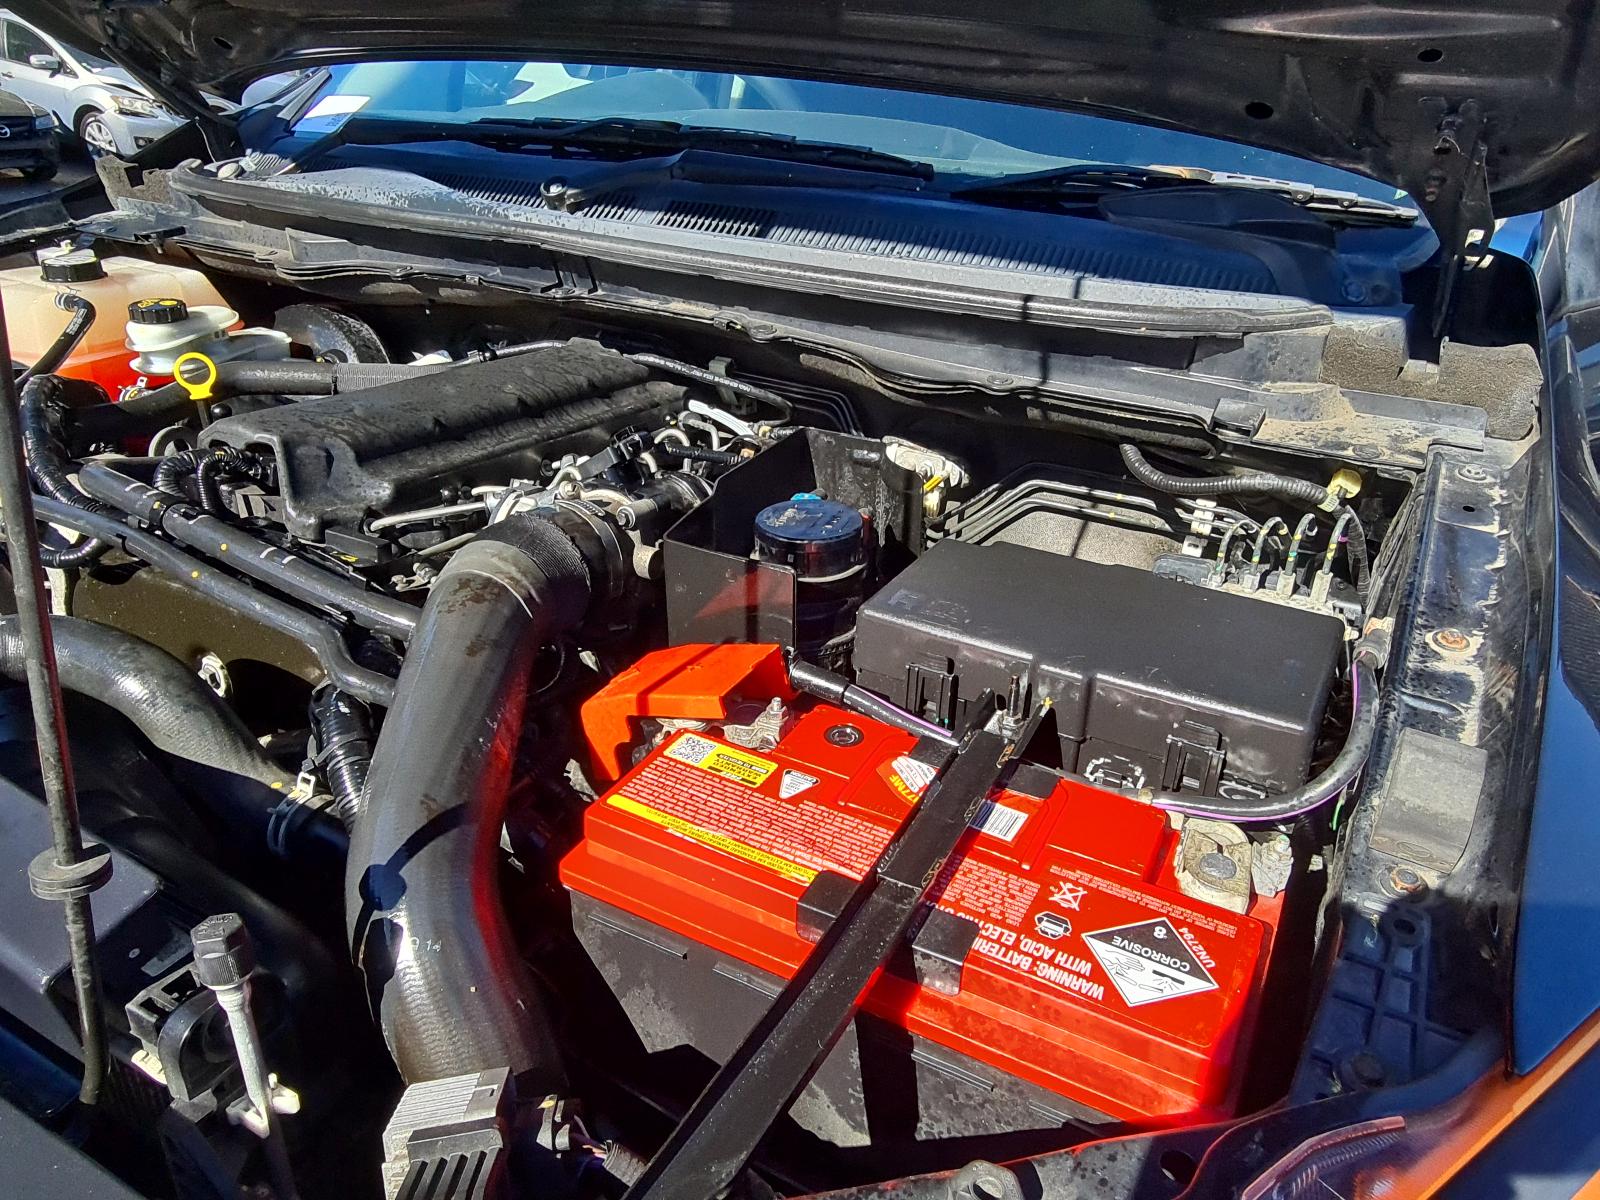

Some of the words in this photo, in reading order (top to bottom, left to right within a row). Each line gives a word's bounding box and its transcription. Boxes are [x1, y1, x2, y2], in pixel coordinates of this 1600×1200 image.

[1016, 933, 1056, 961] ACID,
[1152, 924, 1167, 940] 8
[1177, 926, 1217, 968] UN2794
[1053, 949, 1093, 977] WITH
[1110, 934, 1191, 973] CORROSIVE
[1032, 959, 1105, 1001] WARNING:
